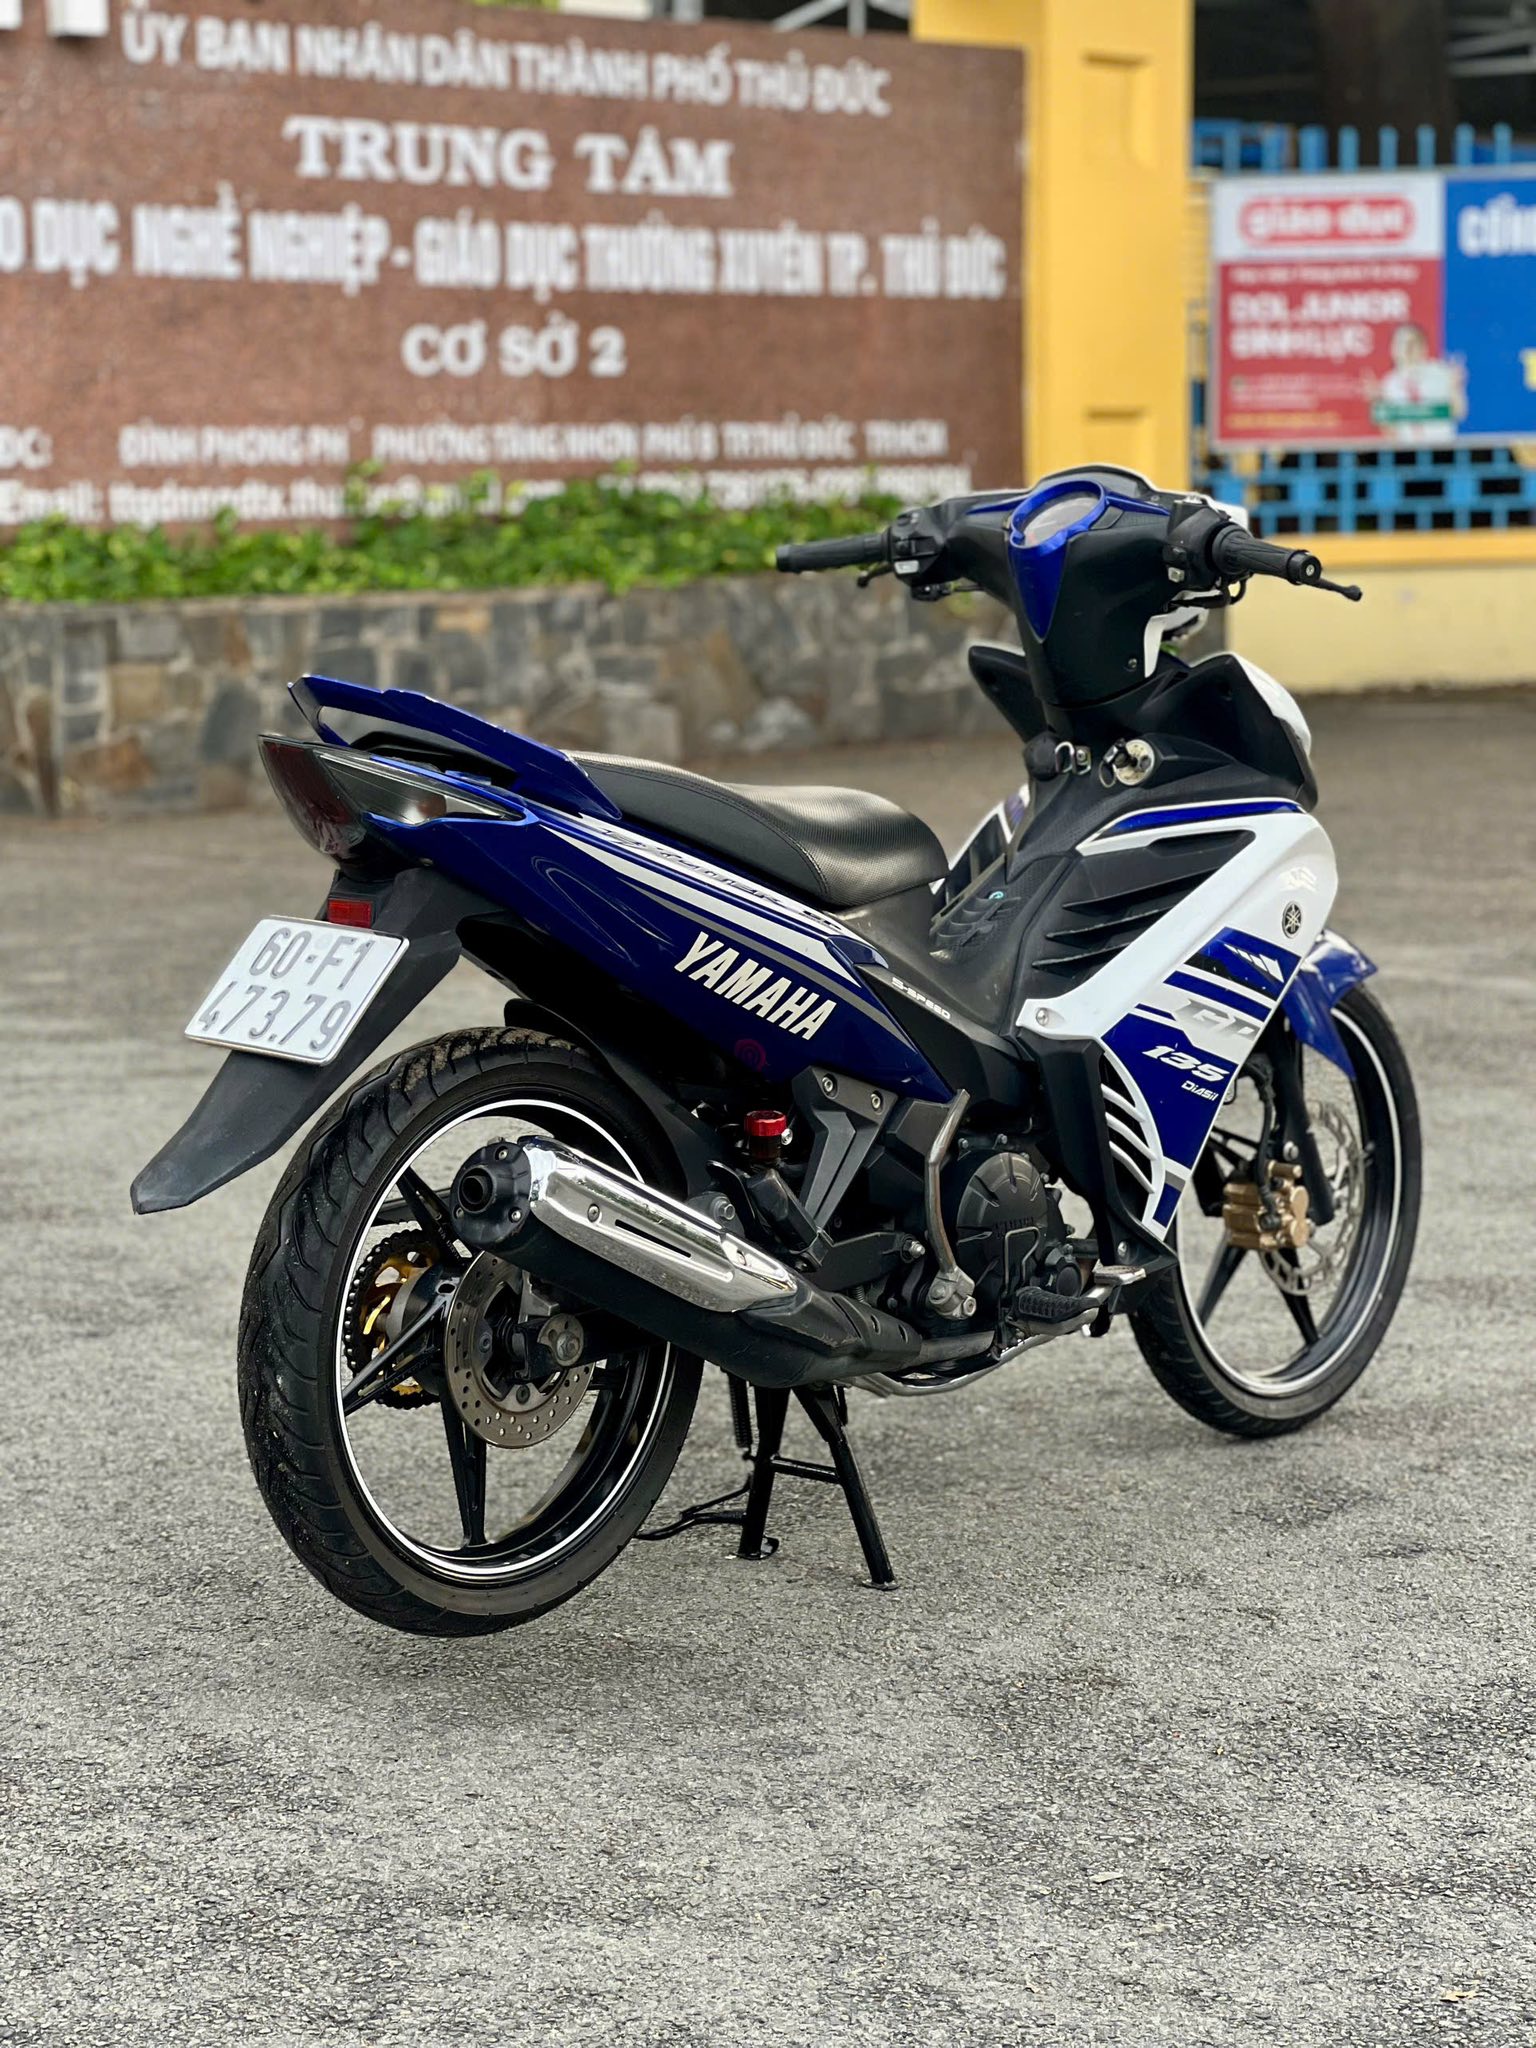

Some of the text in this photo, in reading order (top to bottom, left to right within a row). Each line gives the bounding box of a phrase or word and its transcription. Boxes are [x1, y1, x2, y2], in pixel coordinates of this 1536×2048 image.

[196, 16, 291, 74] BAN
[297, 21, 418, 82] NHÂN
[420, 28, 511, 90] DÂN
[513, 36, 649, 99] THÀNH
[652, 42, 733, 105] PHỐ
[734, 49, 808, 112] THỦ
[813, 56, 893, 117] ĐỨC
[281, 113, 736, 198] TRUNG TÂM
[32, 198, 121, 290] DỤC
[131, 181, 243, 280] NGHỀ
[247, 202, 391, 297] NGHIỆP
[413, 205, 500, 291] GIÁO
[505, 220, 580, 304] DỤC
[581, 207, 715, 295] THƯỜNG
[718, 217, 822, 297] XUYÊN
[879, 214, 942, 299] THỦ
[944, 222, 1007, 300] ĐỨC
[402, 309, 629, 379] CƠ SỞ 2
[249, 927, 375, 991] 60-F1
[674, 931, 837, 1041] YAMAHA
[198, 980, 351, 1051] 473.79
[1141, 1045, 1231, 1082] 135
